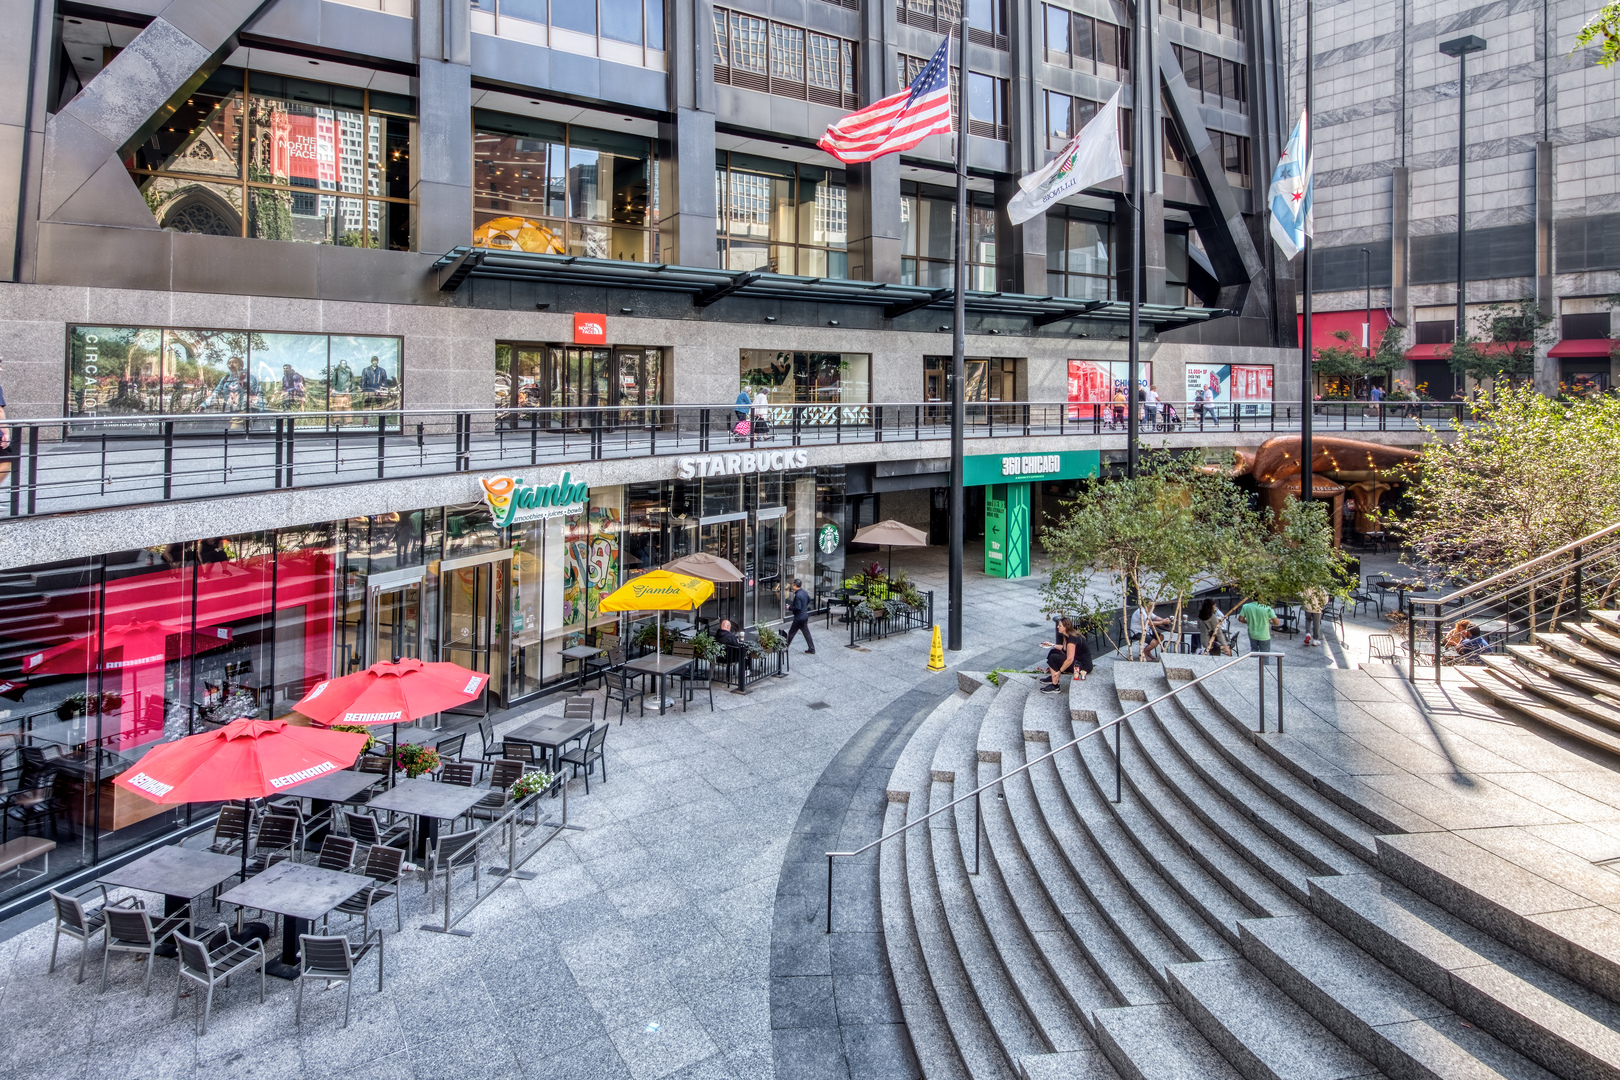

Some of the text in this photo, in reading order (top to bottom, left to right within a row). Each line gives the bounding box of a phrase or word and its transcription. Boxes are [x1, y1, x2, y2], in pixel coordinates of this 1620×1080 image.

[279, 140, 317, 152] NORTH
[296, 135, 317, 145] THE
[290, 149, 317, 160] FACE
[1114, 379, 1148, 388] CHIO
[677, 449, 808, 480] STARBUCKS
[1002, 455, 1061, 476] 360 CHICAGO
[496, 471, 590, 528] jamba
[513, 507, 583, 523] smoothies juices bowls
[635, 585, 681, 598] jamba
[343, 711, 402, 722] BENIHANA
[269, 761, 336, 789] BENIHANA
[127, 772, 175, 797] BENIHANA
